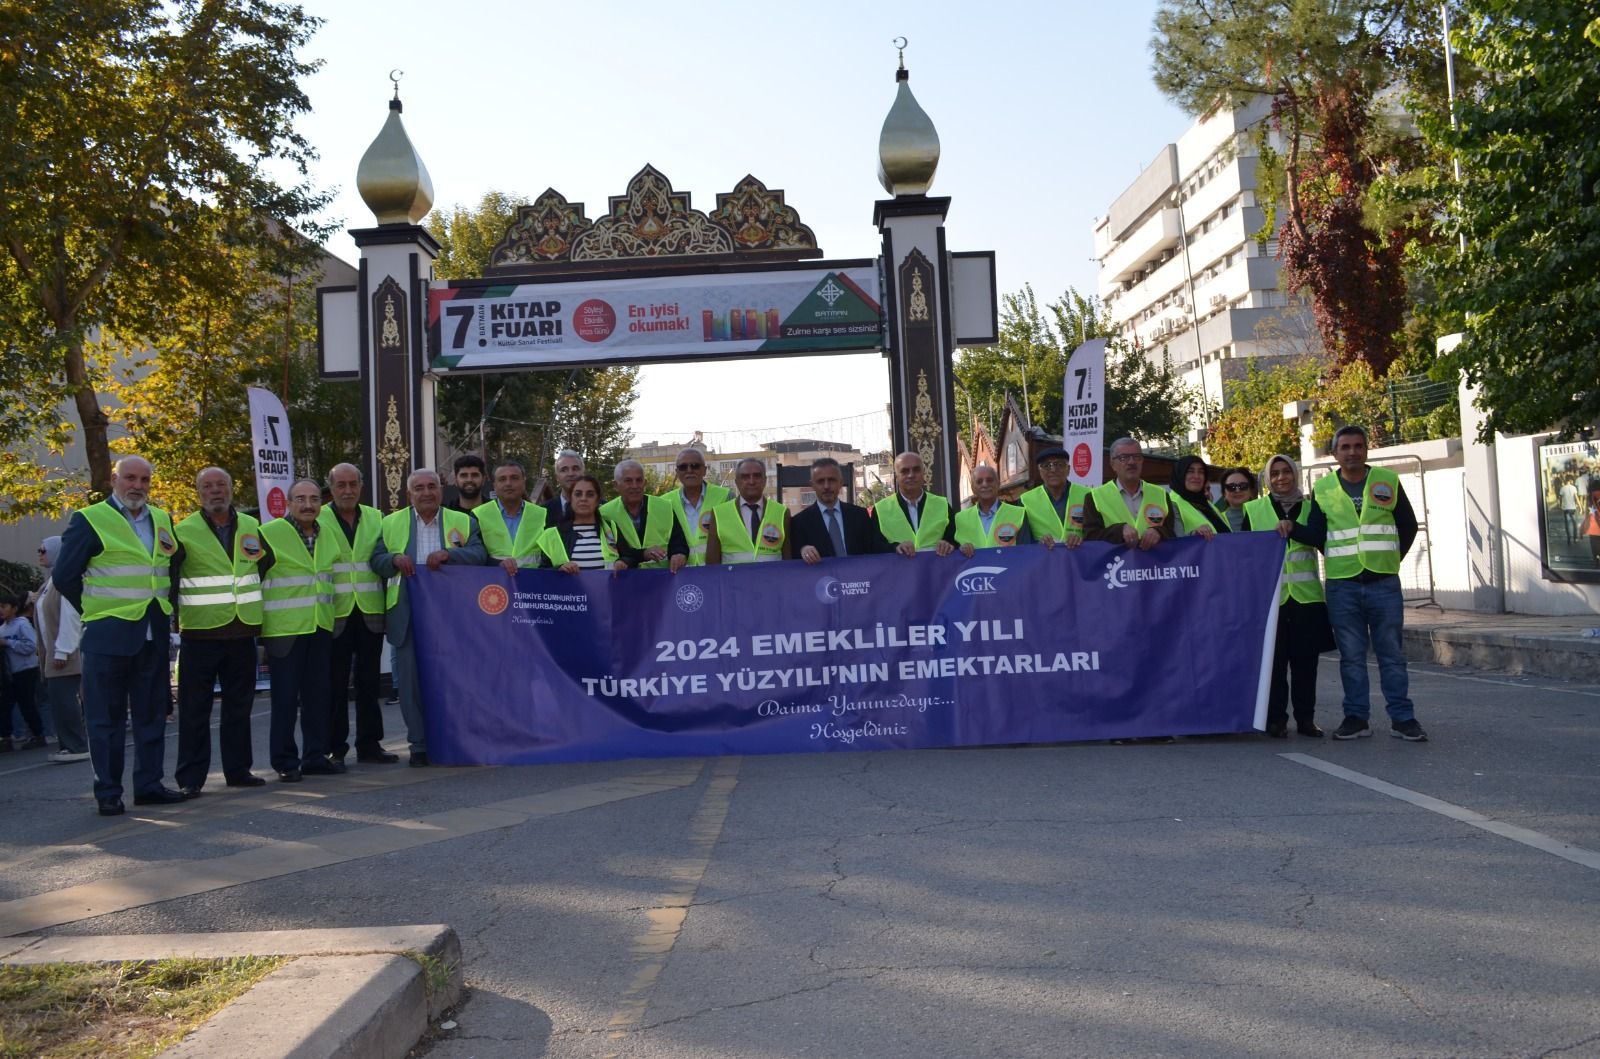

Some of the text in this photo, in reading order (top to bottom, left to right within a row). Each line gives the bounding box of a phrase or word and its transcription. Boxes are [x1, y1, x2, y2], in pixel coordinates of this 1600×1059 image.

[628, 303, 679, 319] En iyisi
[478, 304, 486, 336] BATMAN
[628, 316, 690, 333] okumak!
[491, 320, 563, 338] FUARI
[1068, 417, 1098, 431] FUARI
[1120, 565, 1200, 582] EMEKLİLER YILI
[961, 576, 996, 593] SGK
[513, 592, 587, 602] TÜRKİYE CUMHURİYETİ
[513, 601, 587, 612] CUMHURBAŞKANLIĞI
[655, 618, 1024, 662] 2024 EMEKLİLER YILI
[581, 672, 708, 698] TÜRKİYE
[898, 651, 1100, 680] EMEKTARLARI
[757, 700, 824, 717] Daima
[809, 721, 908, 744] Hoşgeldiniz
